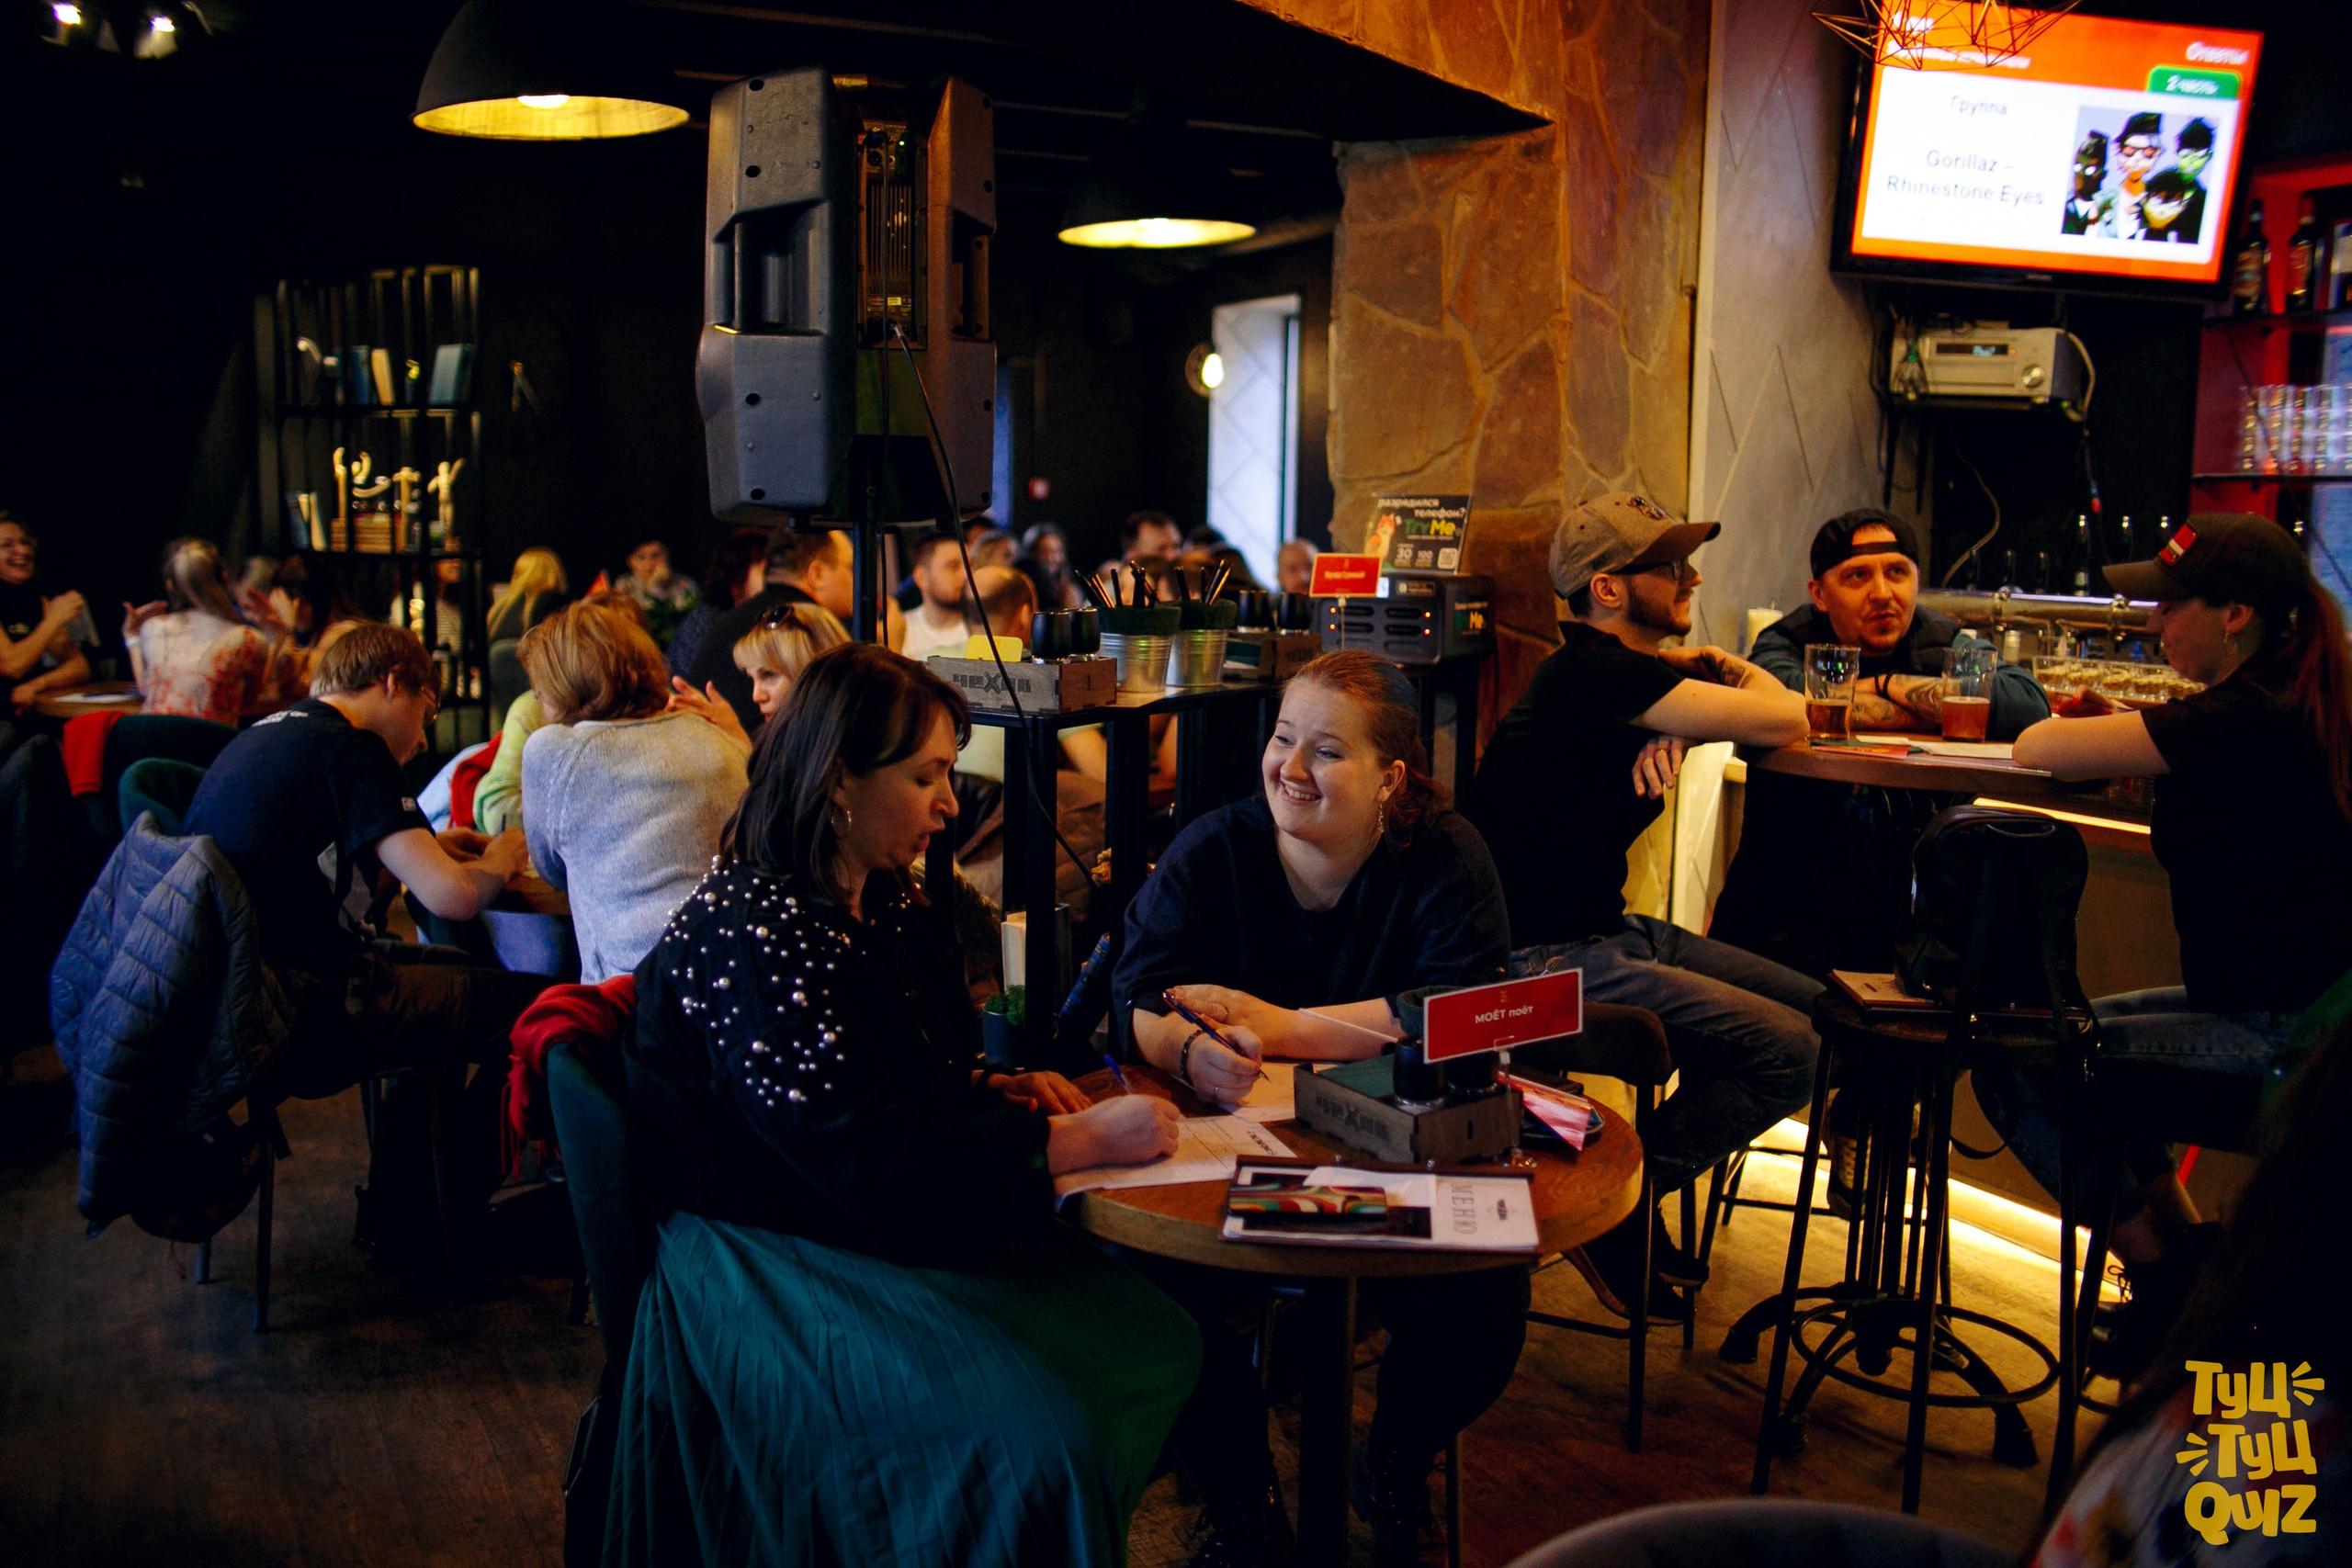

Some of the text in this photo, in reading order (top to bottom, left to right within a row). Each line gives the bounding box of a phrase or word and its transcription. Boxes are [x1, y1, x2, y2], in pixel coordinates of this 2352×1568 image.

[1950, 95, 2009, 116] Группа
[1926, 149, 1998, 172] Gorillaz
[1886, 175, 2044, 207] Rhinestone Eyes
[1414, 506, 1466, 519] телефон?
[1509, 1004, 1533, 1018] поёт
